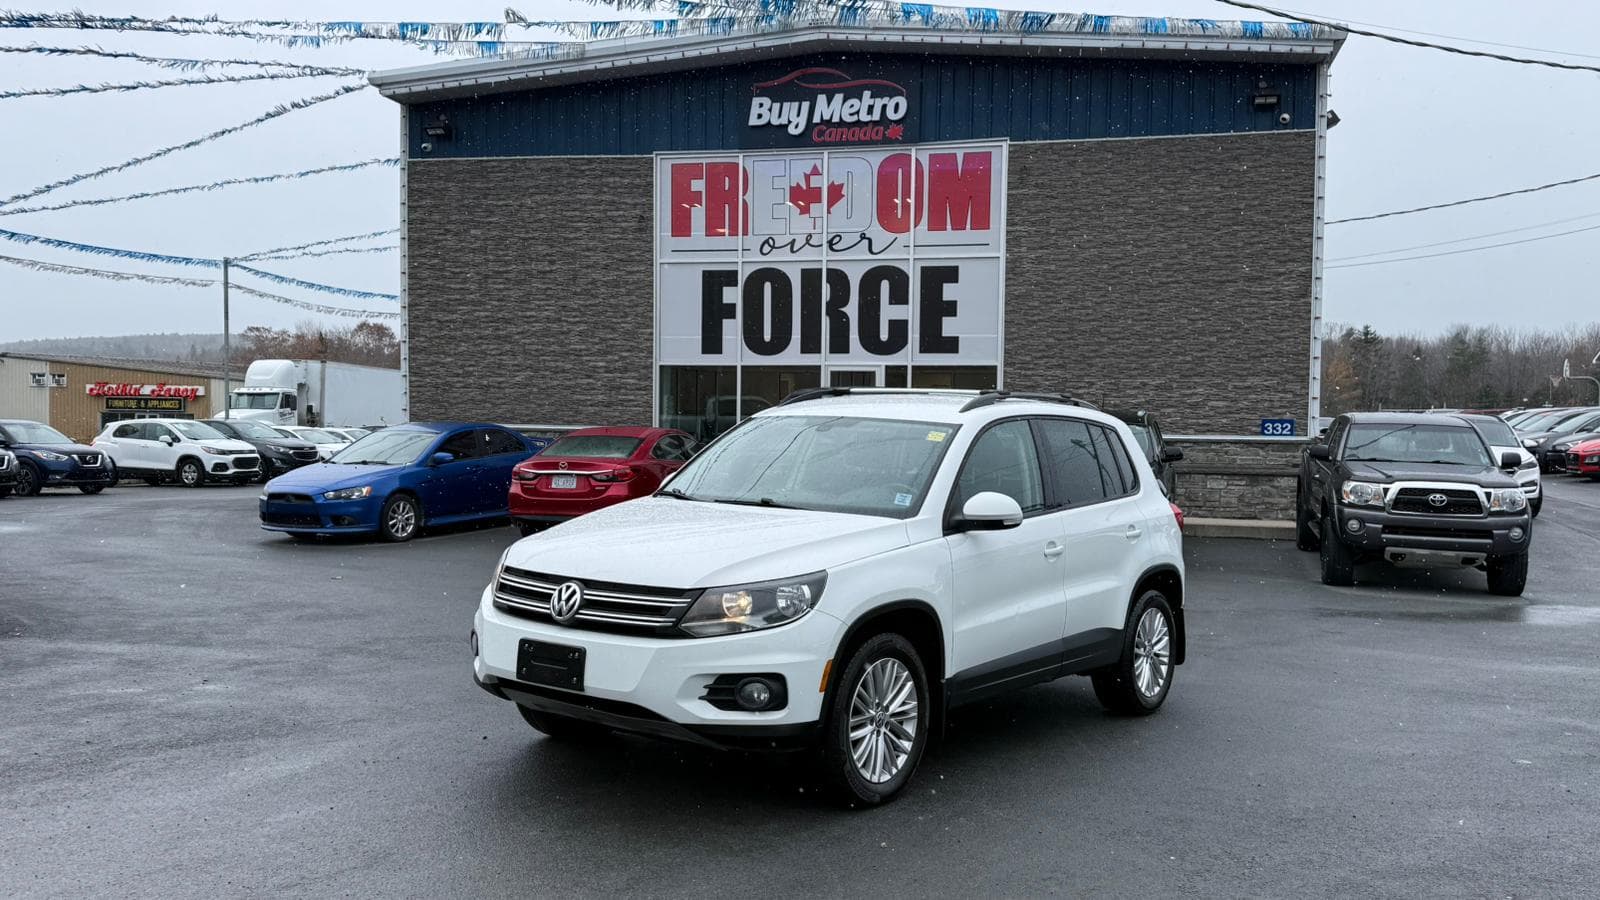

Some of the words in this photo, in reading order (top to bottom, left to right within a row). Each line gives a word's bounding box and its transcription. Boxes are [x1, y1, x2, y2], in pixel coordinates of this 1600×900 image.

[748, 97, 810, 135] Buy
[812, 90, 908, 124] Metro
[812, 123, 884, 143] Canada
[671, 151, 992, 237] FREEDOM
[759, 232, 897, 255] over
[701, 265, 960, 356] FORCE
[108, 399, 138, 409] FURNITURE
[147, 399, 180, 409] APPLIANCES
[1264, 423, 1291, 435] 332
